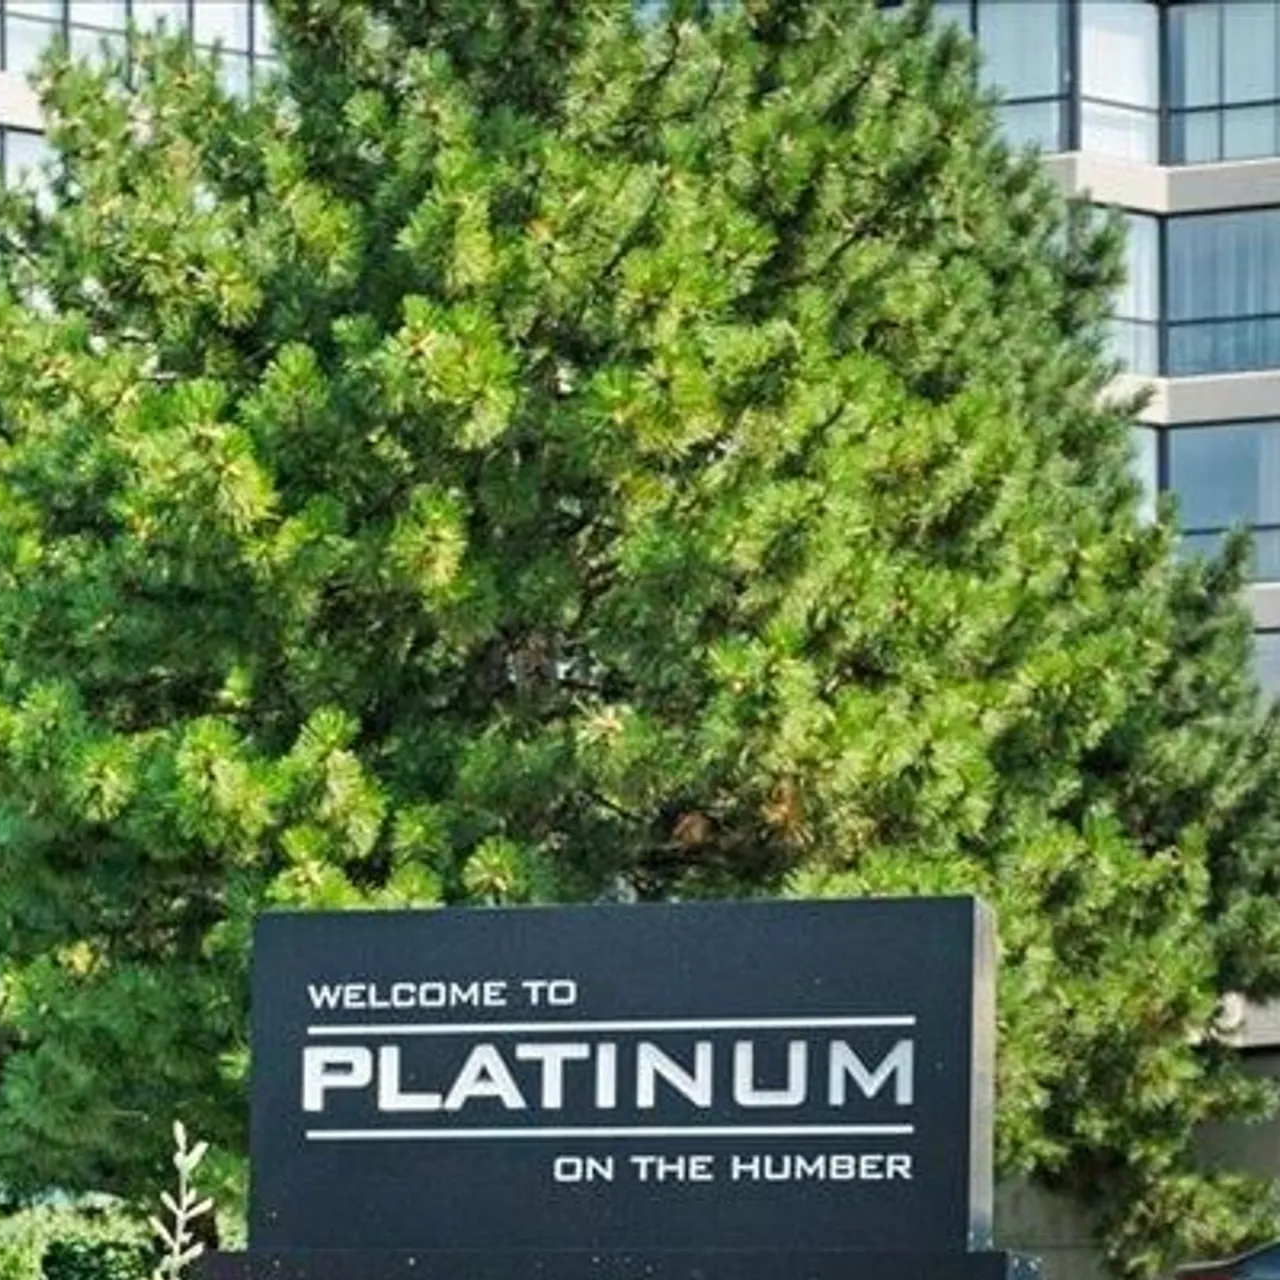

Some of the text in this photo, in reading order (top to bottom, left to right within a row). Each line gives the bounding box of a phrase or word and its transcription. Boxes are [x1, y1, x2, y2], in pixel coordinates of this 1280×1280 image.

[307, 978, 578, 1009] WELCOME TO
[301, 1038, 915, 1113] PLATINUM
[553, 1153, 913, 1183] ON THE HUMBER
